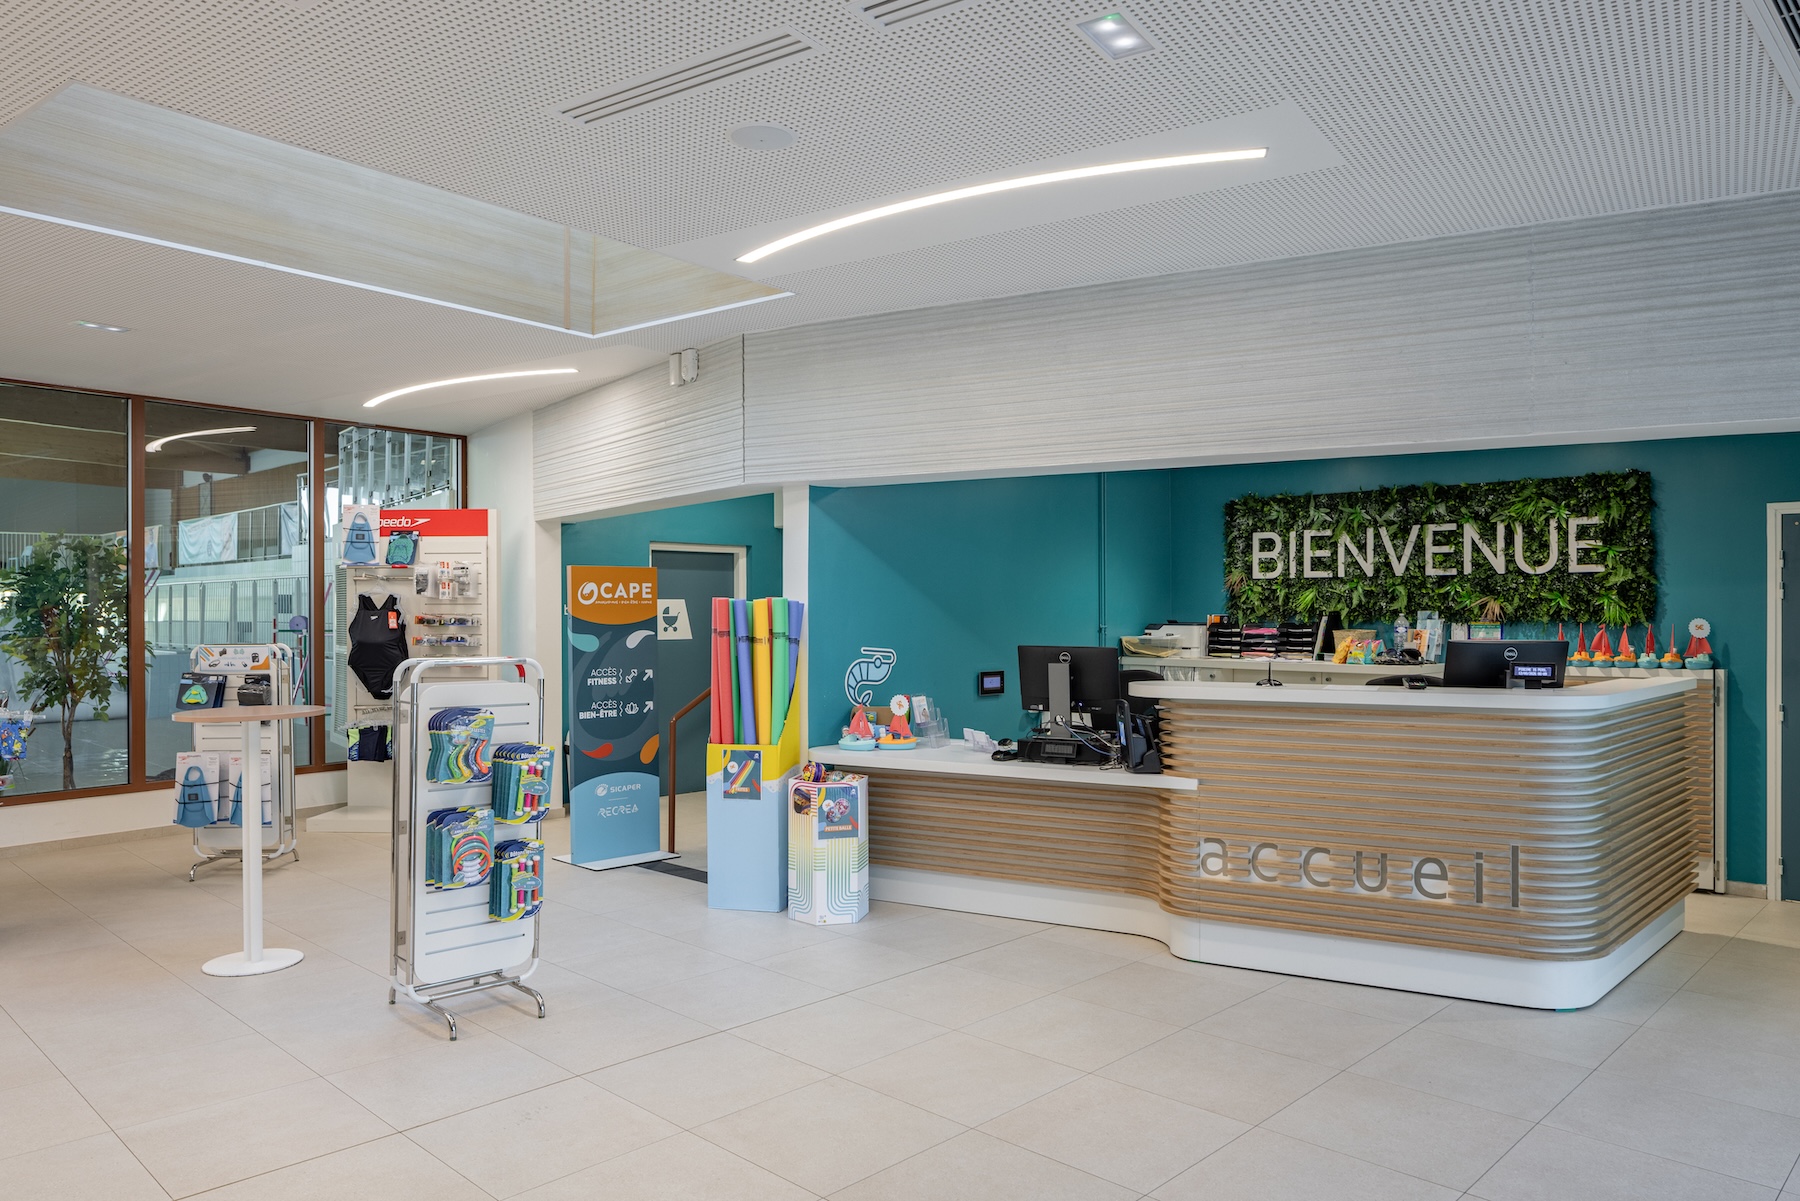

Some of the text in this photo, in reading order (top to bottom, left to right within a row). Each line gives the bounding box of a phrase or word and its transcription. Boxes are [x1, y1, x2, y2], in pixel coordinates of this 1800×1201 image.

[380, 516, 412, 528] eedo
[1251, 516, 1606, 580] BIENVENUE
[591, 667, 617, 677] ACCÈS
[587, 677, 617, 686] FITNESS
[591, 699, 617, 710] ACCÈS
[579, 709, 618, 720] BIEN-ÊTRE
[610, 783, 641, 793] SICAPER
[1200, 837, 1520, 908] accueil
